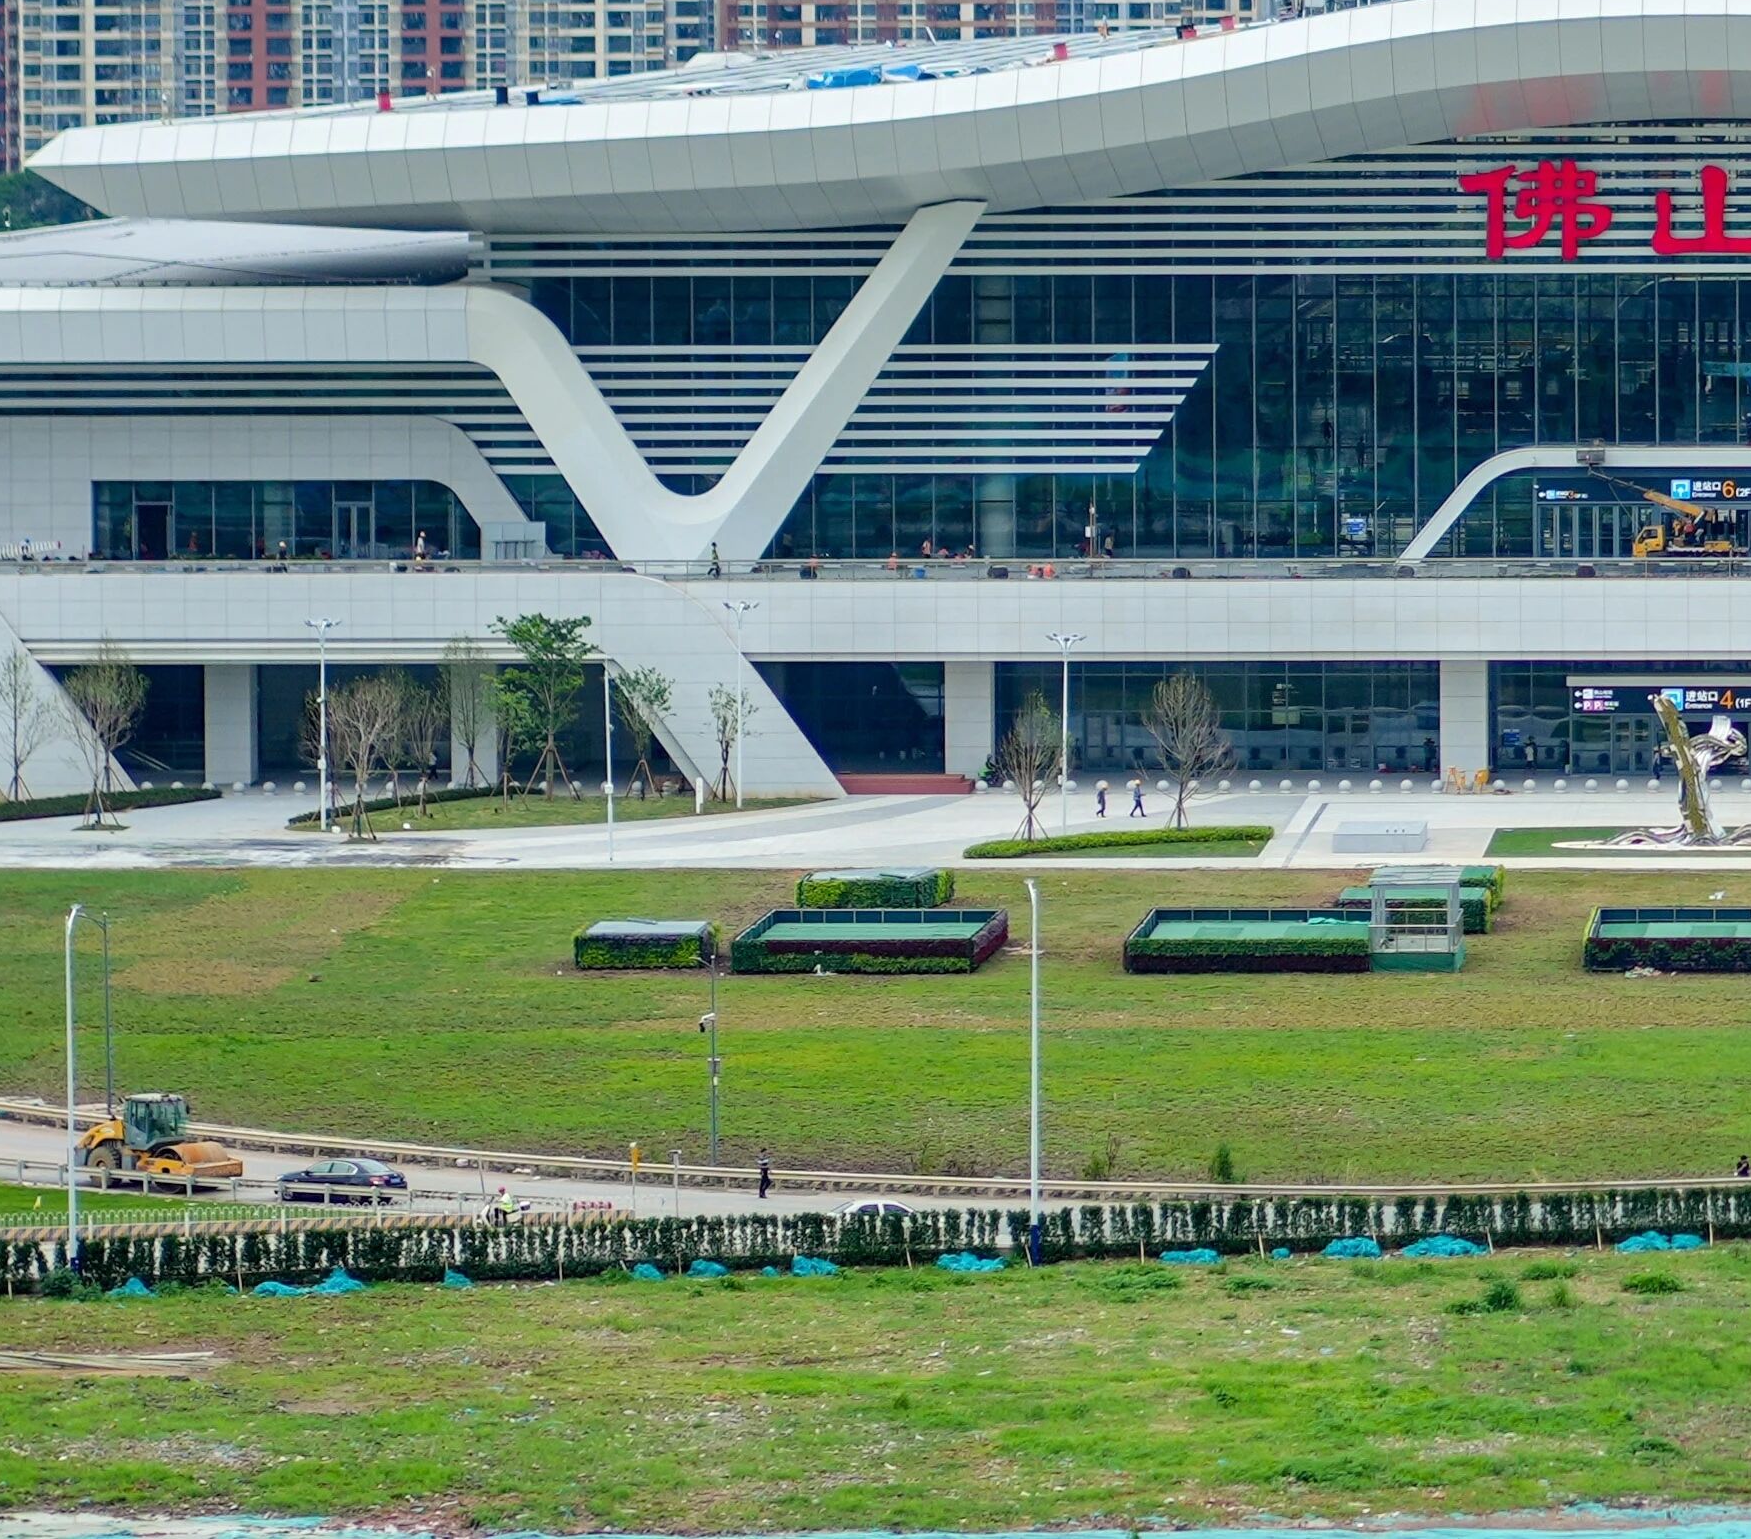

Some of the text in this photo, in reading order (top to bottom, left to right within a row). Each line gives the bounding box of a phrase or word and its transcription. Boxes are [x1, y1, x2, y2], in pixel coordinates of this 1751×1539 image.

[1722, 480, 1735, 498] 6
[1685, 690, 1719, 702] 进站口
[1719, 689, 1734, 709] 4
